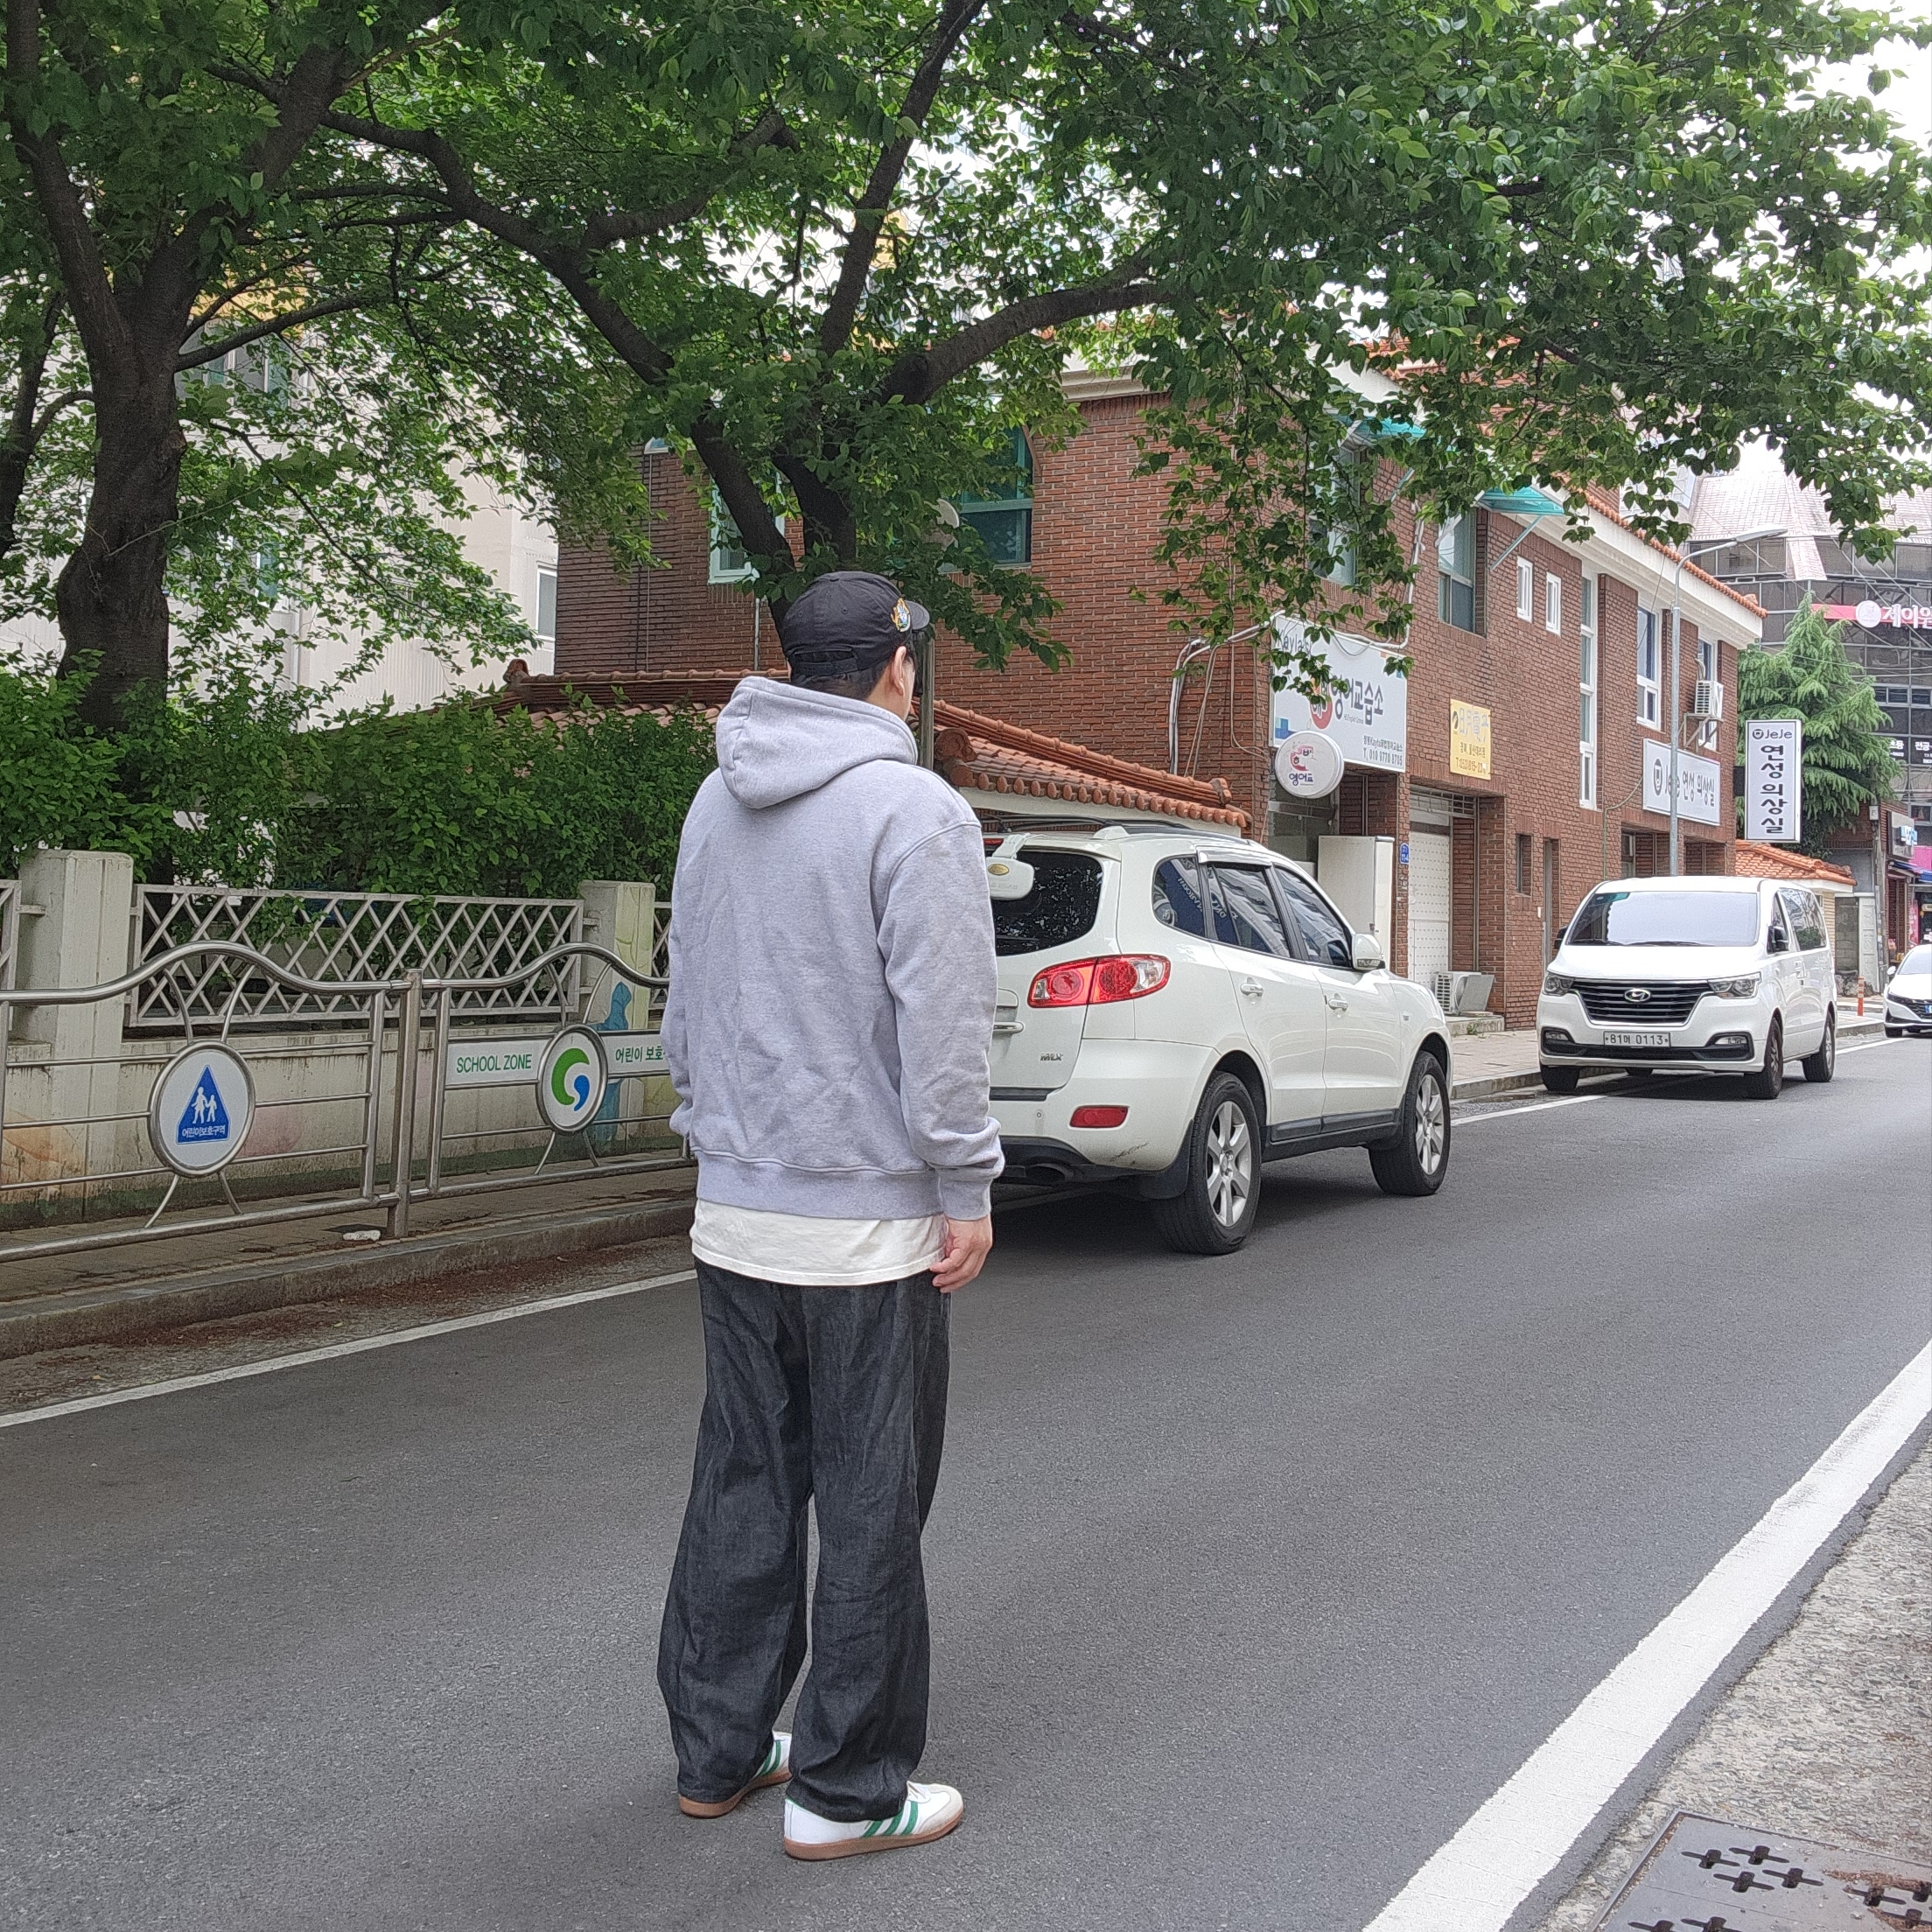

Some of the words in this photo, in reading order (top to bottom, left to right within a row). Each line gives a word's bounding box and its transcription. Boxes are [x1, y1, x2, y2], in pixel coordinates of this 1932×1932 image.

[1635, 1034, 1663, 1045] 0113
[615, 1046, 643, 1064] 어린이
[456, 1054, 501, 1074] SCHOOL
[502, 1054, 532, 1070] ZONE
[181, 1124, 227, 1138] 어린이보호구역
